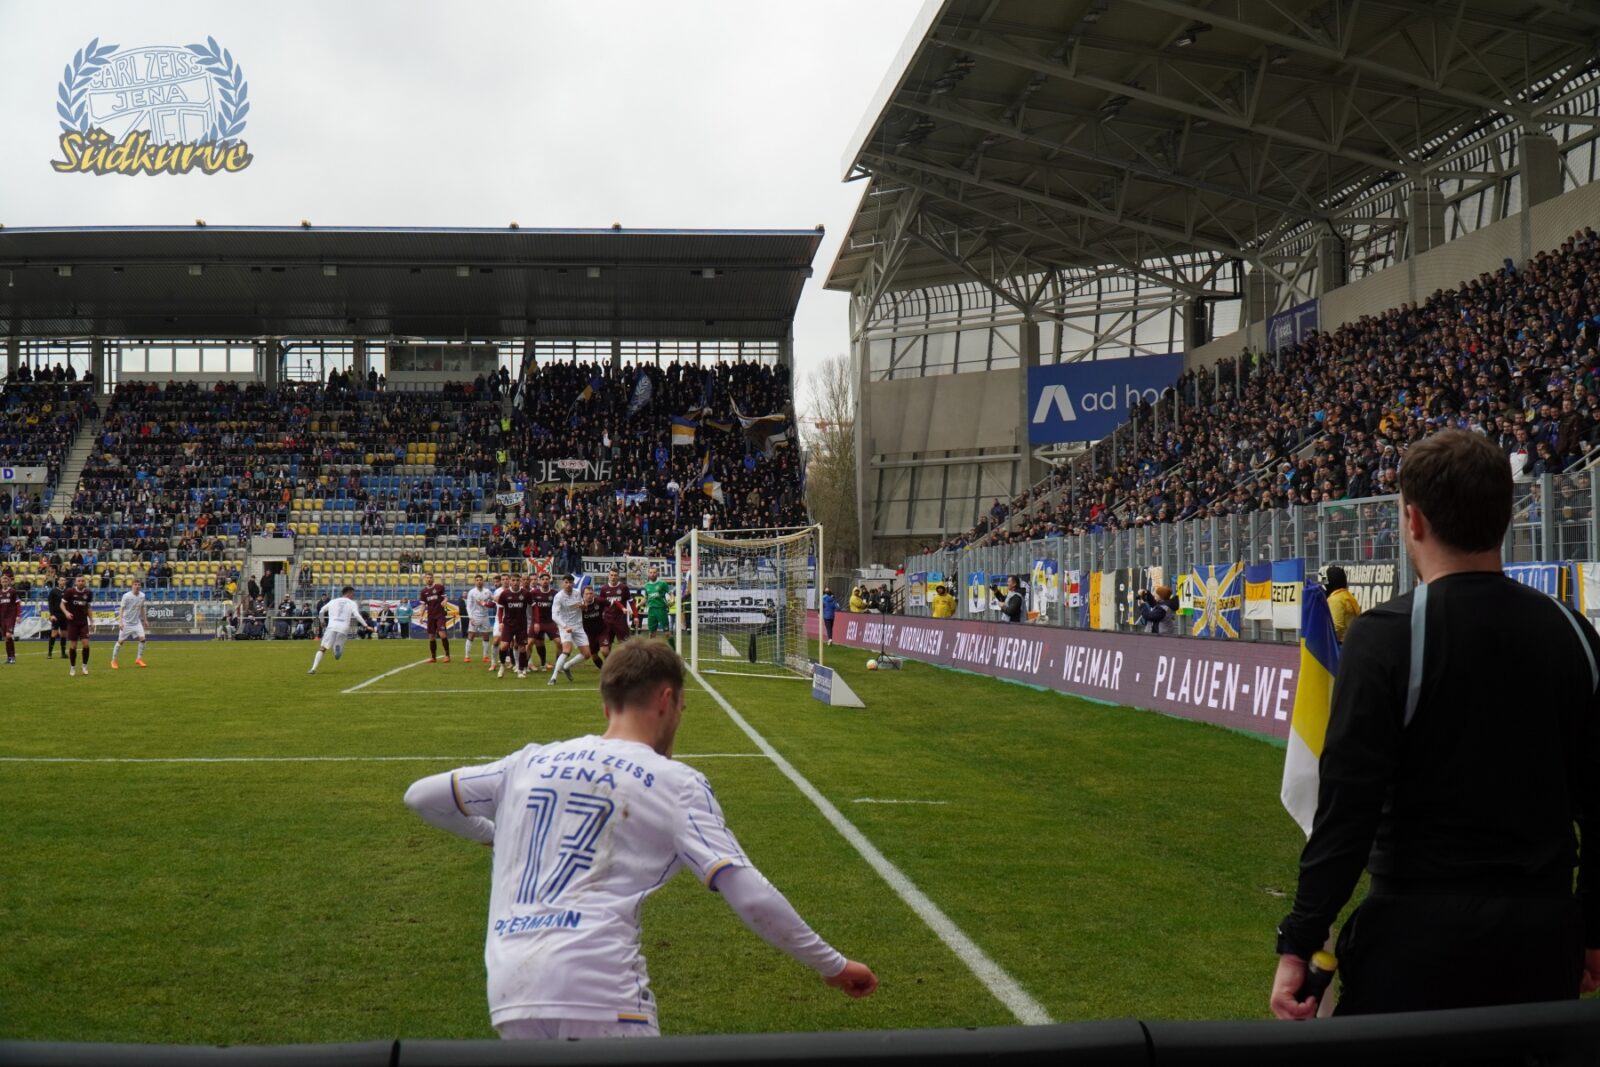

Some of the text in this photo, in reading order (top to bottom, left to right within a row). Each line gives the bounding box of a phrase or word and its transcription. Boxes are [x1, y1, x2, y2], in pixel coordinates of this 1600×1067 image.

[1081, 385, 1116, 412] ad
[3, 468, 14, 479] D
[583, 561, 626, 573] ULTRAS
[1344, 564, 1395, 583] STRAIGHT EDGE
[1272, 585, 1296, 603] ZEITZ
[898, 626, 943, 656] NORDHAUSEN
[952, 632, 1043, 674] ZWICKAU-WERDAU
[1062, 644, 1124, 690] WEIMAR
[1153, 655, 1293, 721] PLAUEN-WE
[527, 750, 655, 788] FC CARL ZEISS
[540, 765, 617, 790] JENA
[516, 787, 615, 905] 17
